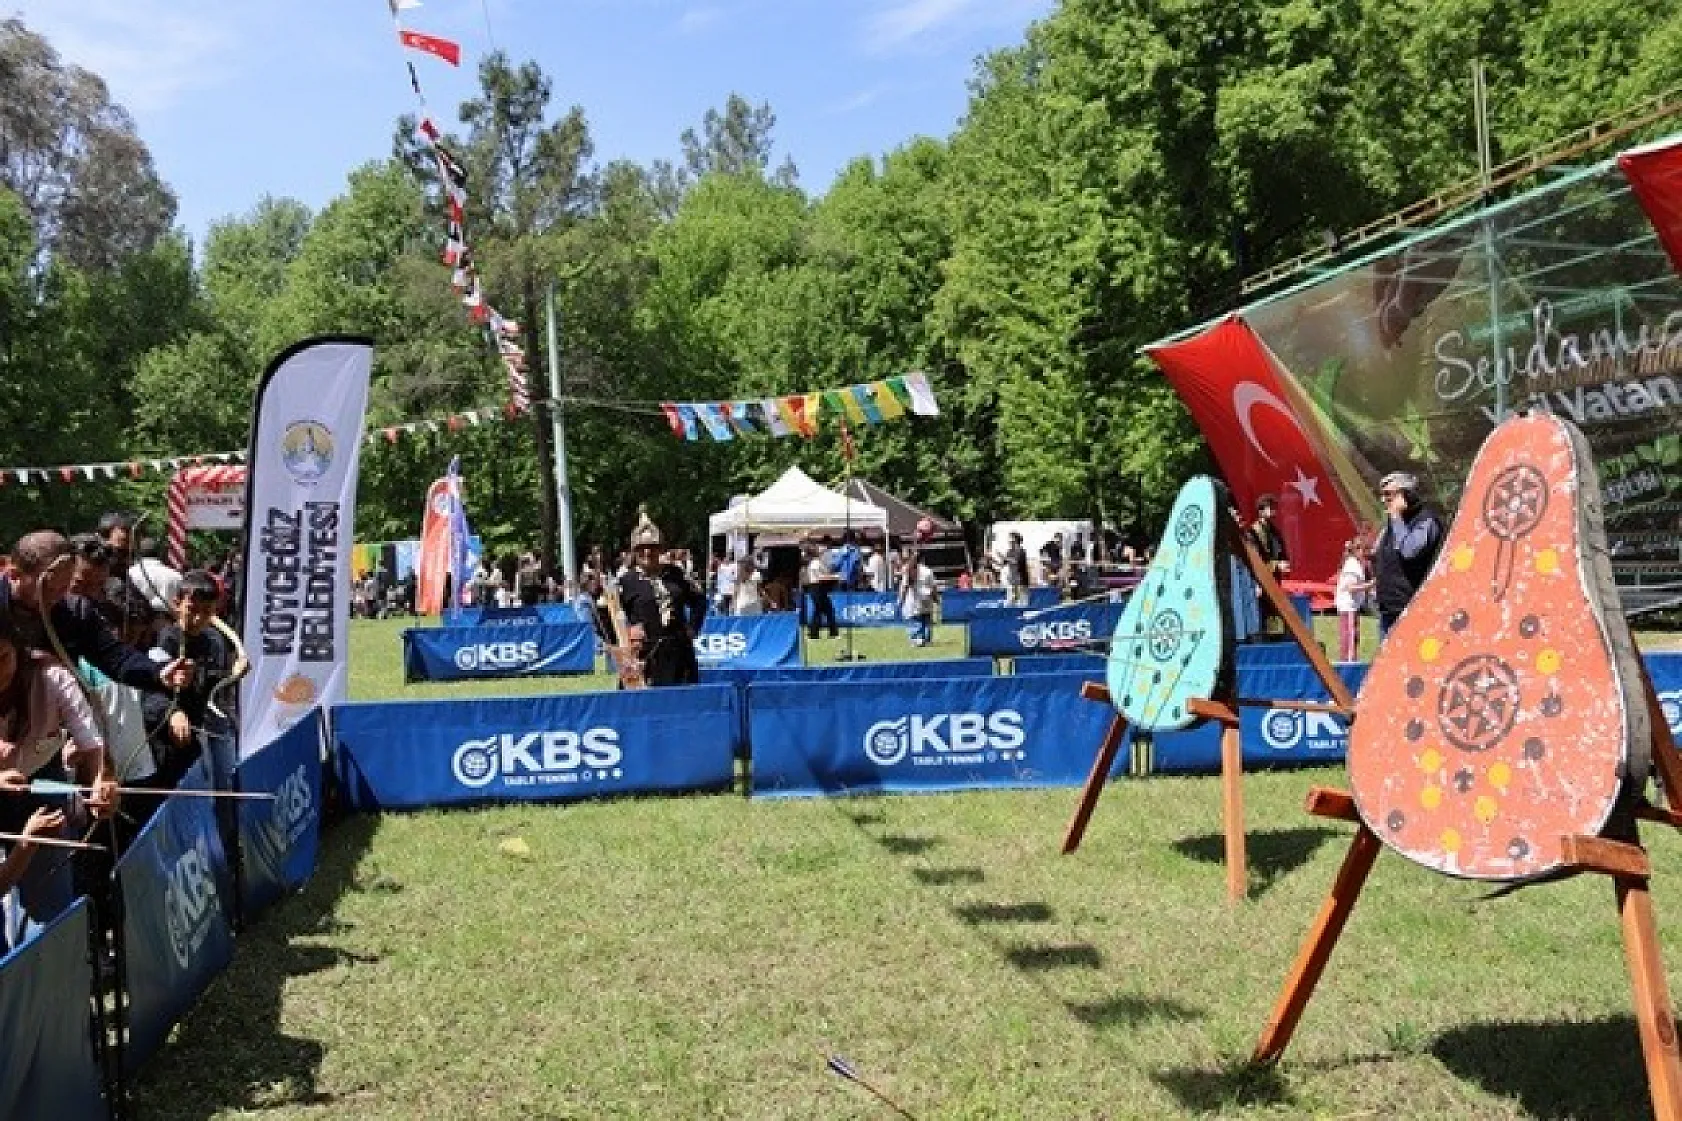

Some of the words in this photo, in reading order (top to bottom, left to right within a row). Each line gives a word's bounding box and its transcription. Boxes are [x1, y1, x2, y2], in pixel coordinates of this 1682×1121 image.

[1556, 376, 1682, 421] Vatan
[299, 501, 340, 662] BELEDİYESİ
[1041, 619, 1091, 640] KBS
[478, 641, 539, 663] KBS
[910, 709, 1024, 752] KBS
[501, 728, 622, 773] KBS
[913, 756, 943, 765] TABLE
[945, 753, 984, 763] TENNIS
[504, 775, 537, 785] TABLE
[538, 772, 578, 782] TENNIS
